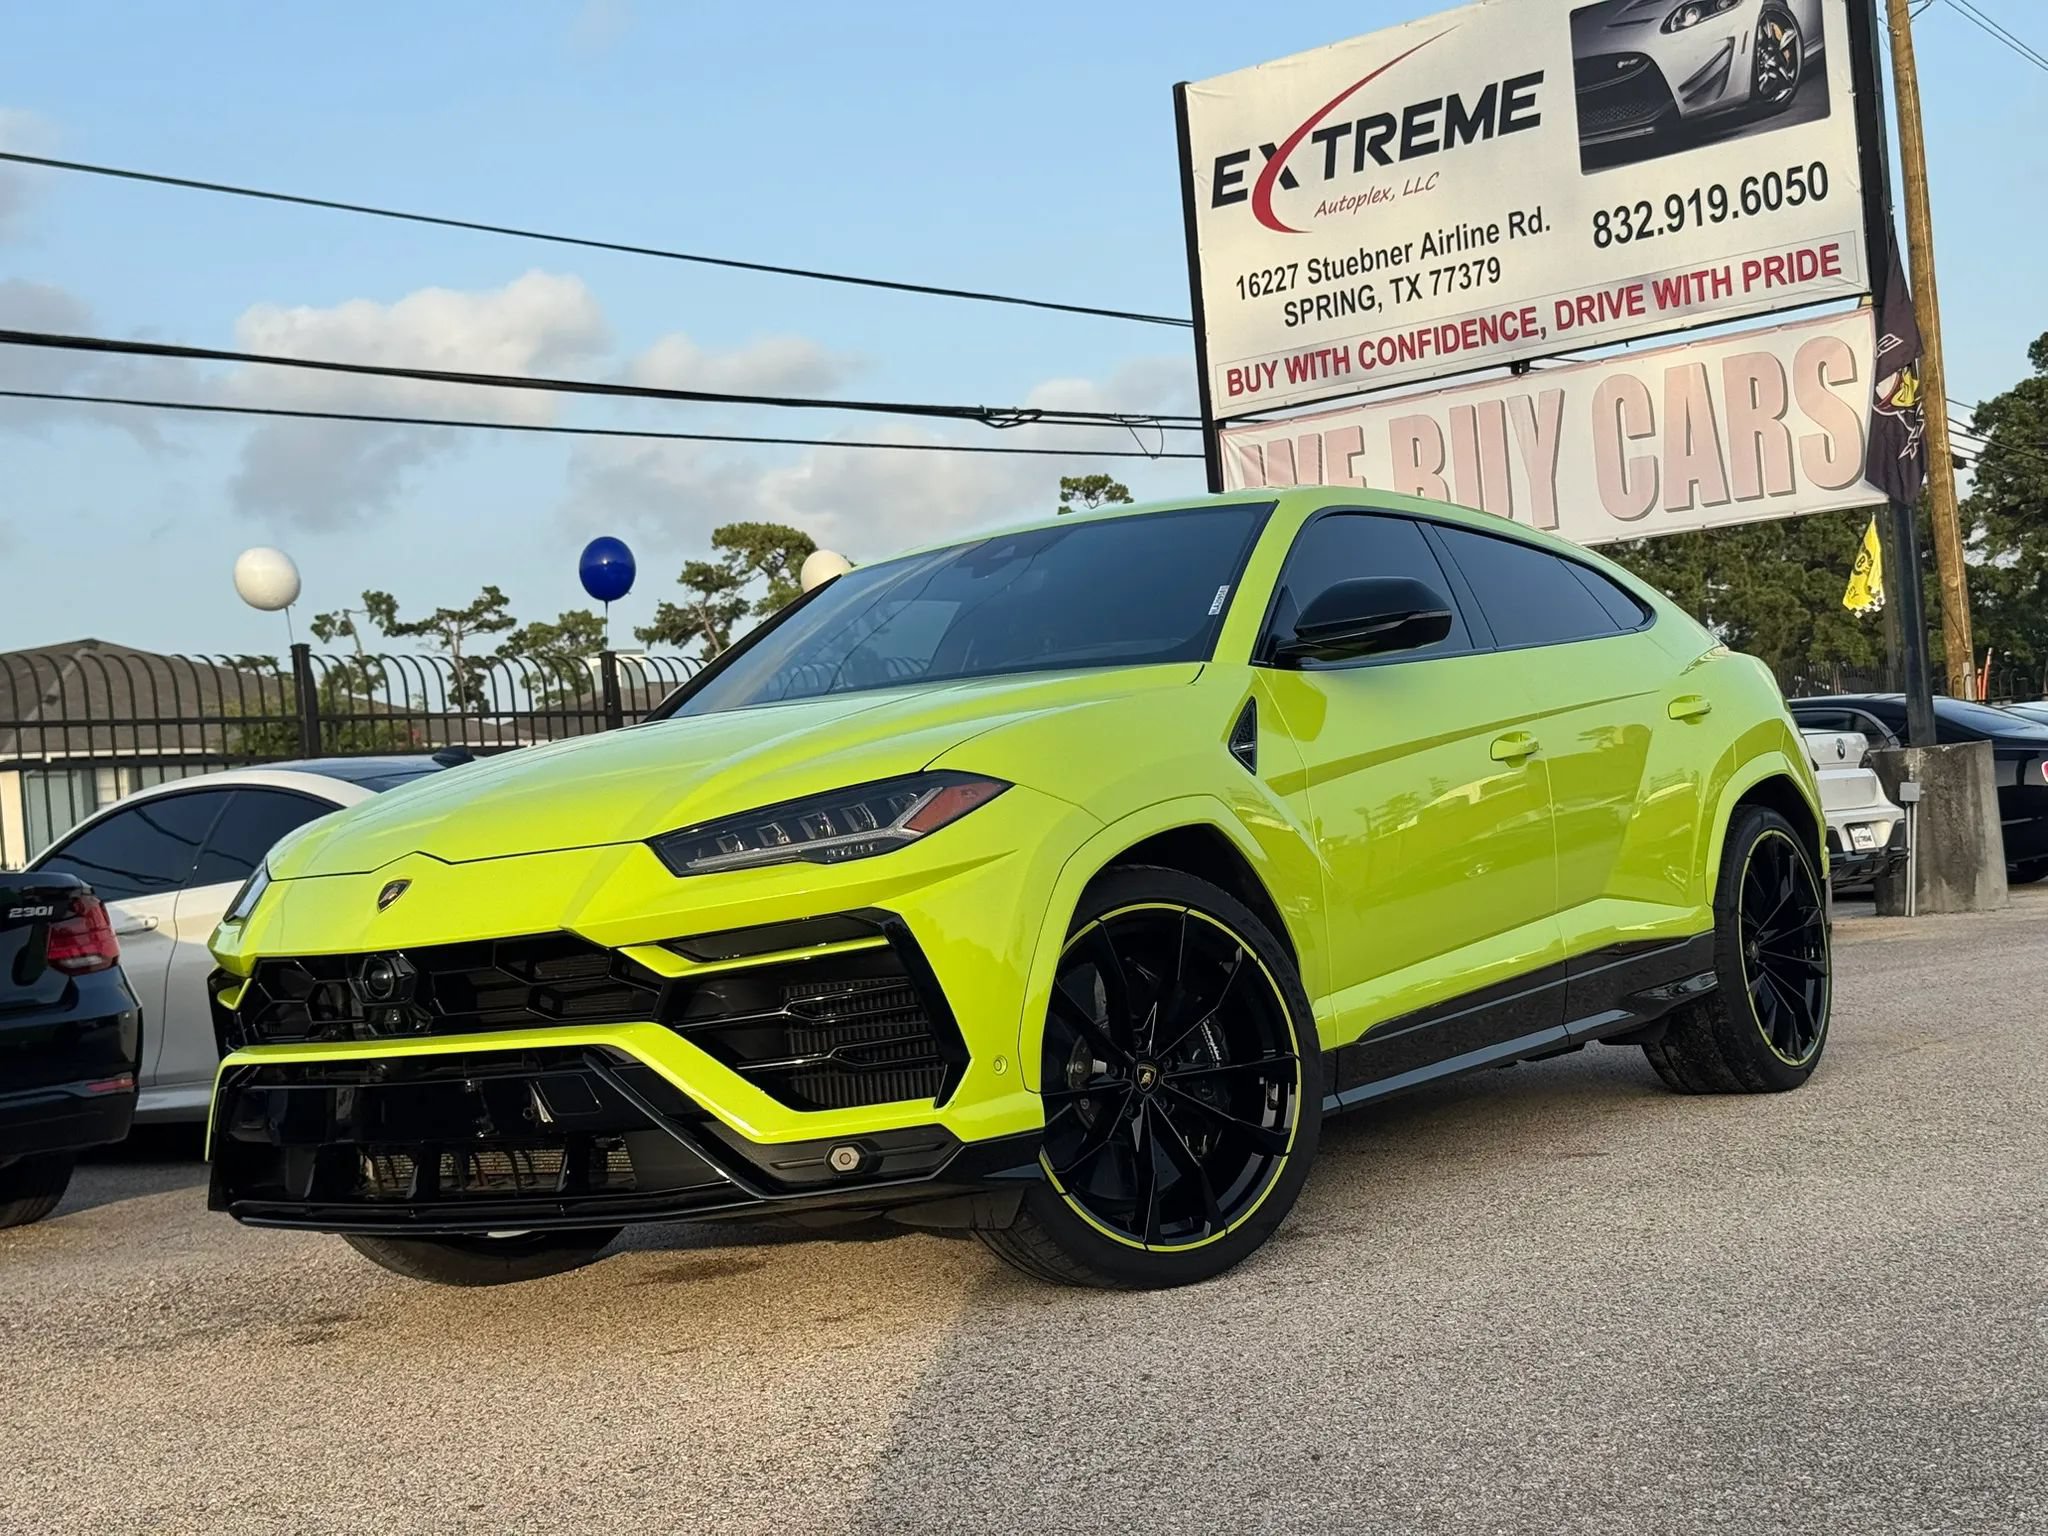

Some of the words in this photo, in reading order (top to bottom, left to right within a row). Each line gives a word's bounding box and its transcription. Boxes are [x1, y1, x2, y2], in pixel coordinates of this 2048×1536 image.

[1211, 69, 1545, 209] EXTREME
[1313, 184, 1396, 219] Autoplex,
[1401, 171, 1441, 198] LLC
[1592, 160, 1829, 249] 832.919.6050
[1235, 263, 1300, 301] 16227
[1306, 242, 1414, 285] Stuebner
[1419, 221, 1501, 260] Airline
[1507, 205, 1552, 240] Rd.
[1283, 283, 1384, 329] SPRING,
[1389, 272, 1424, 304] TX
[1428, 256, 1502, 294] 77379
[1226, 359, 1279, 397] BUY
[1284, 345, 1351, 385] WITH
[1357, 305, 1547, 370] CONFIDENCE,
[1554, 283, 1646, 332] DRIVE
[1651, 264, 1733, 311] WITH
[1741, 242, 1842, 294] PRIDE
[1388, 387, 1565, 531] BUY
[1591, 335, 1865, 522] CARS
